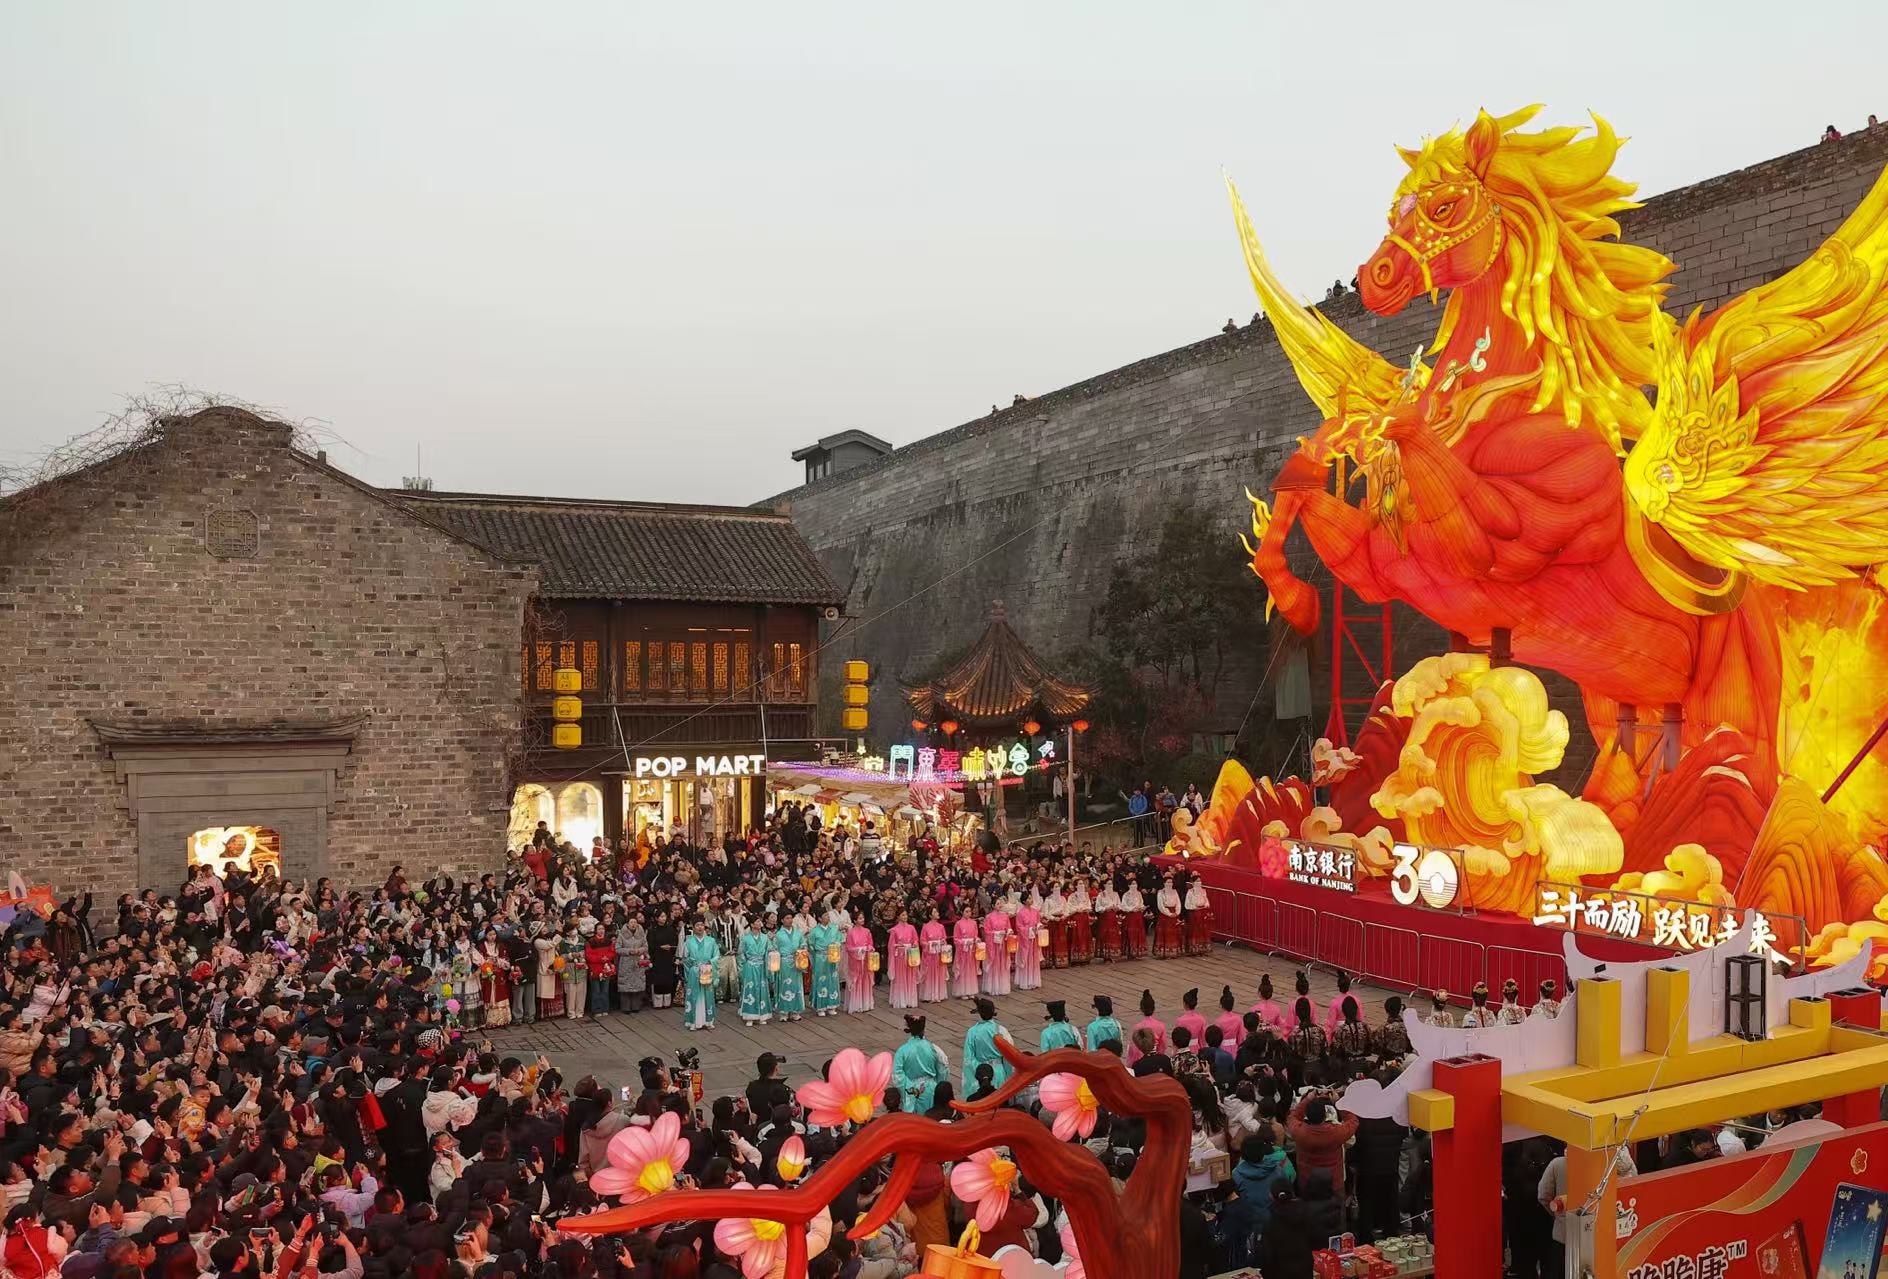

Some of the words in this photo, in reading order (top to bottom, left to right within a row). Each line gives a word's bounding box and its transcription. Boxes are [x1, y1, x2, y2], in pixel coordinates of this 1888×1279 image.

[635, 757, 687, 777] POP
[696, 755, 765, 776] MART
[1289, 844, 1355, 880] 南京银行
[1390, 844, 1458, 909] 30
[1289, 872, 1309, 883] BANK
[1310, 876, 1320, 885] OF
[1321, 878, 1354, 892] NANJING
[1532, 890, 1642, 939] 三十而励
